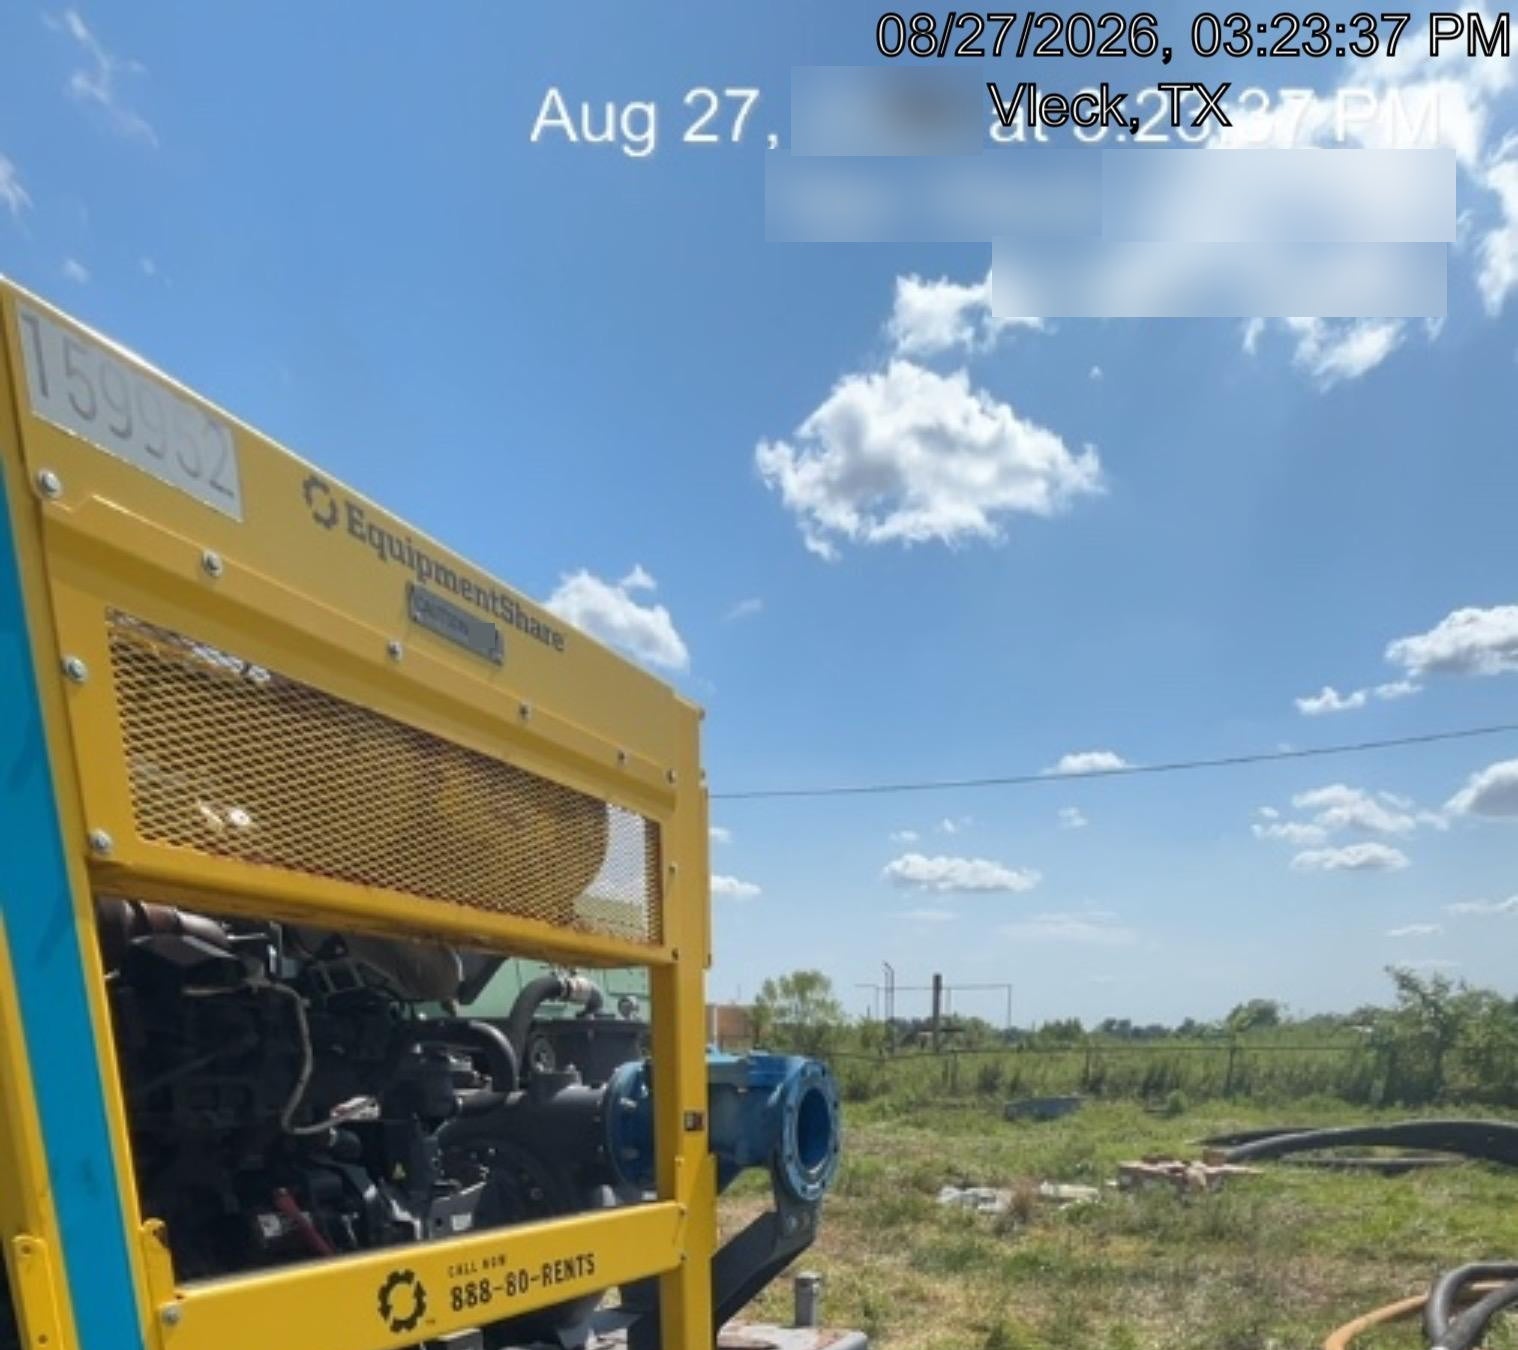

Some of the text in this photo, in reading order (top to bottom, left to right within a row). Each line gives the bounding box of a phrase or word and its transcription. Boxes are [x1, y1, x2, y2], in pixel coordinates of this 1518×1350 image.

[20, 309, 235, 498] 159952
[346, 500, 565, 652] EquipmentShare
[450, 1252, 596, 1313] 888-80-RENTS
